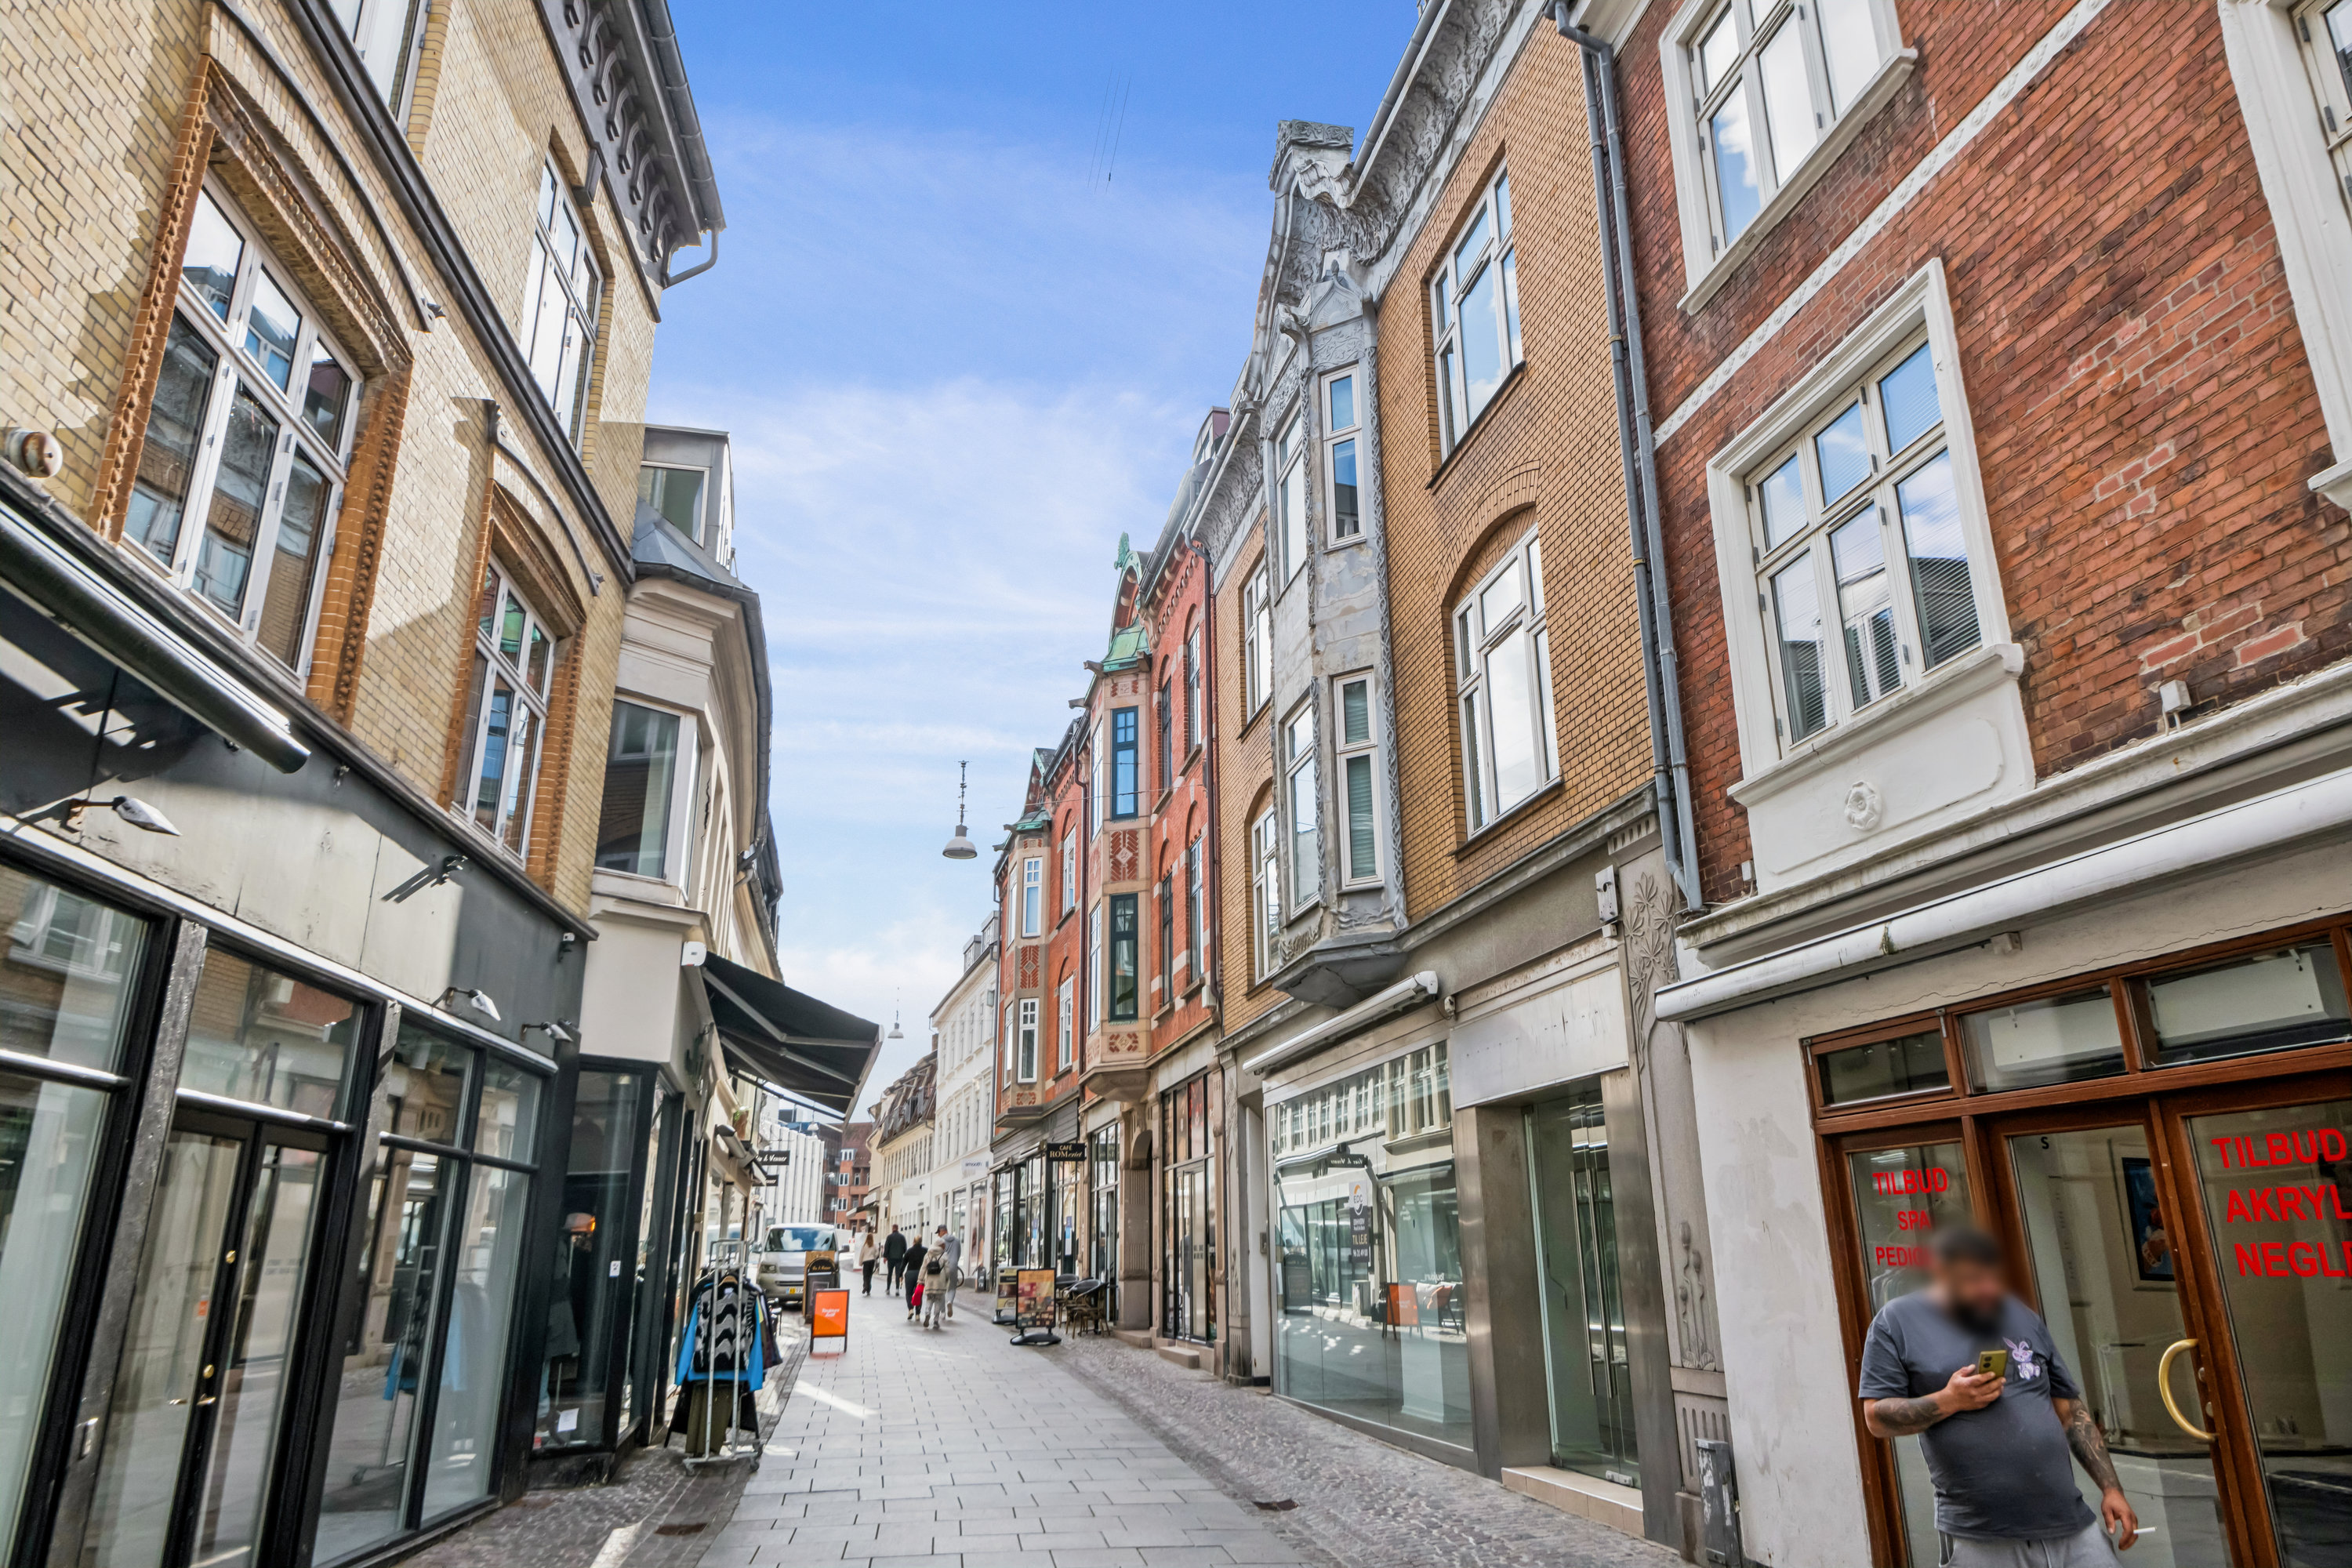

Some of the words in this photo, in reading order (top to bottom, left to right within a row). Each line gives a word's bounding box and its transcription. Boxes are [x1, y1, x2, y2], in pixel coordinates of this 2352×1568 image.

[2211, 1128, 2347, 1169] TILBUD
[1872, 1167, 1948, 1196] TILBUD
[1353, 1194, 1363, 1203] EDC
[2227, 1184, 2352, 1223] AKRYL
[1897, 1210, 1932, 1231] SPA
[1359, 1234, 1368, 1245] LEJE
